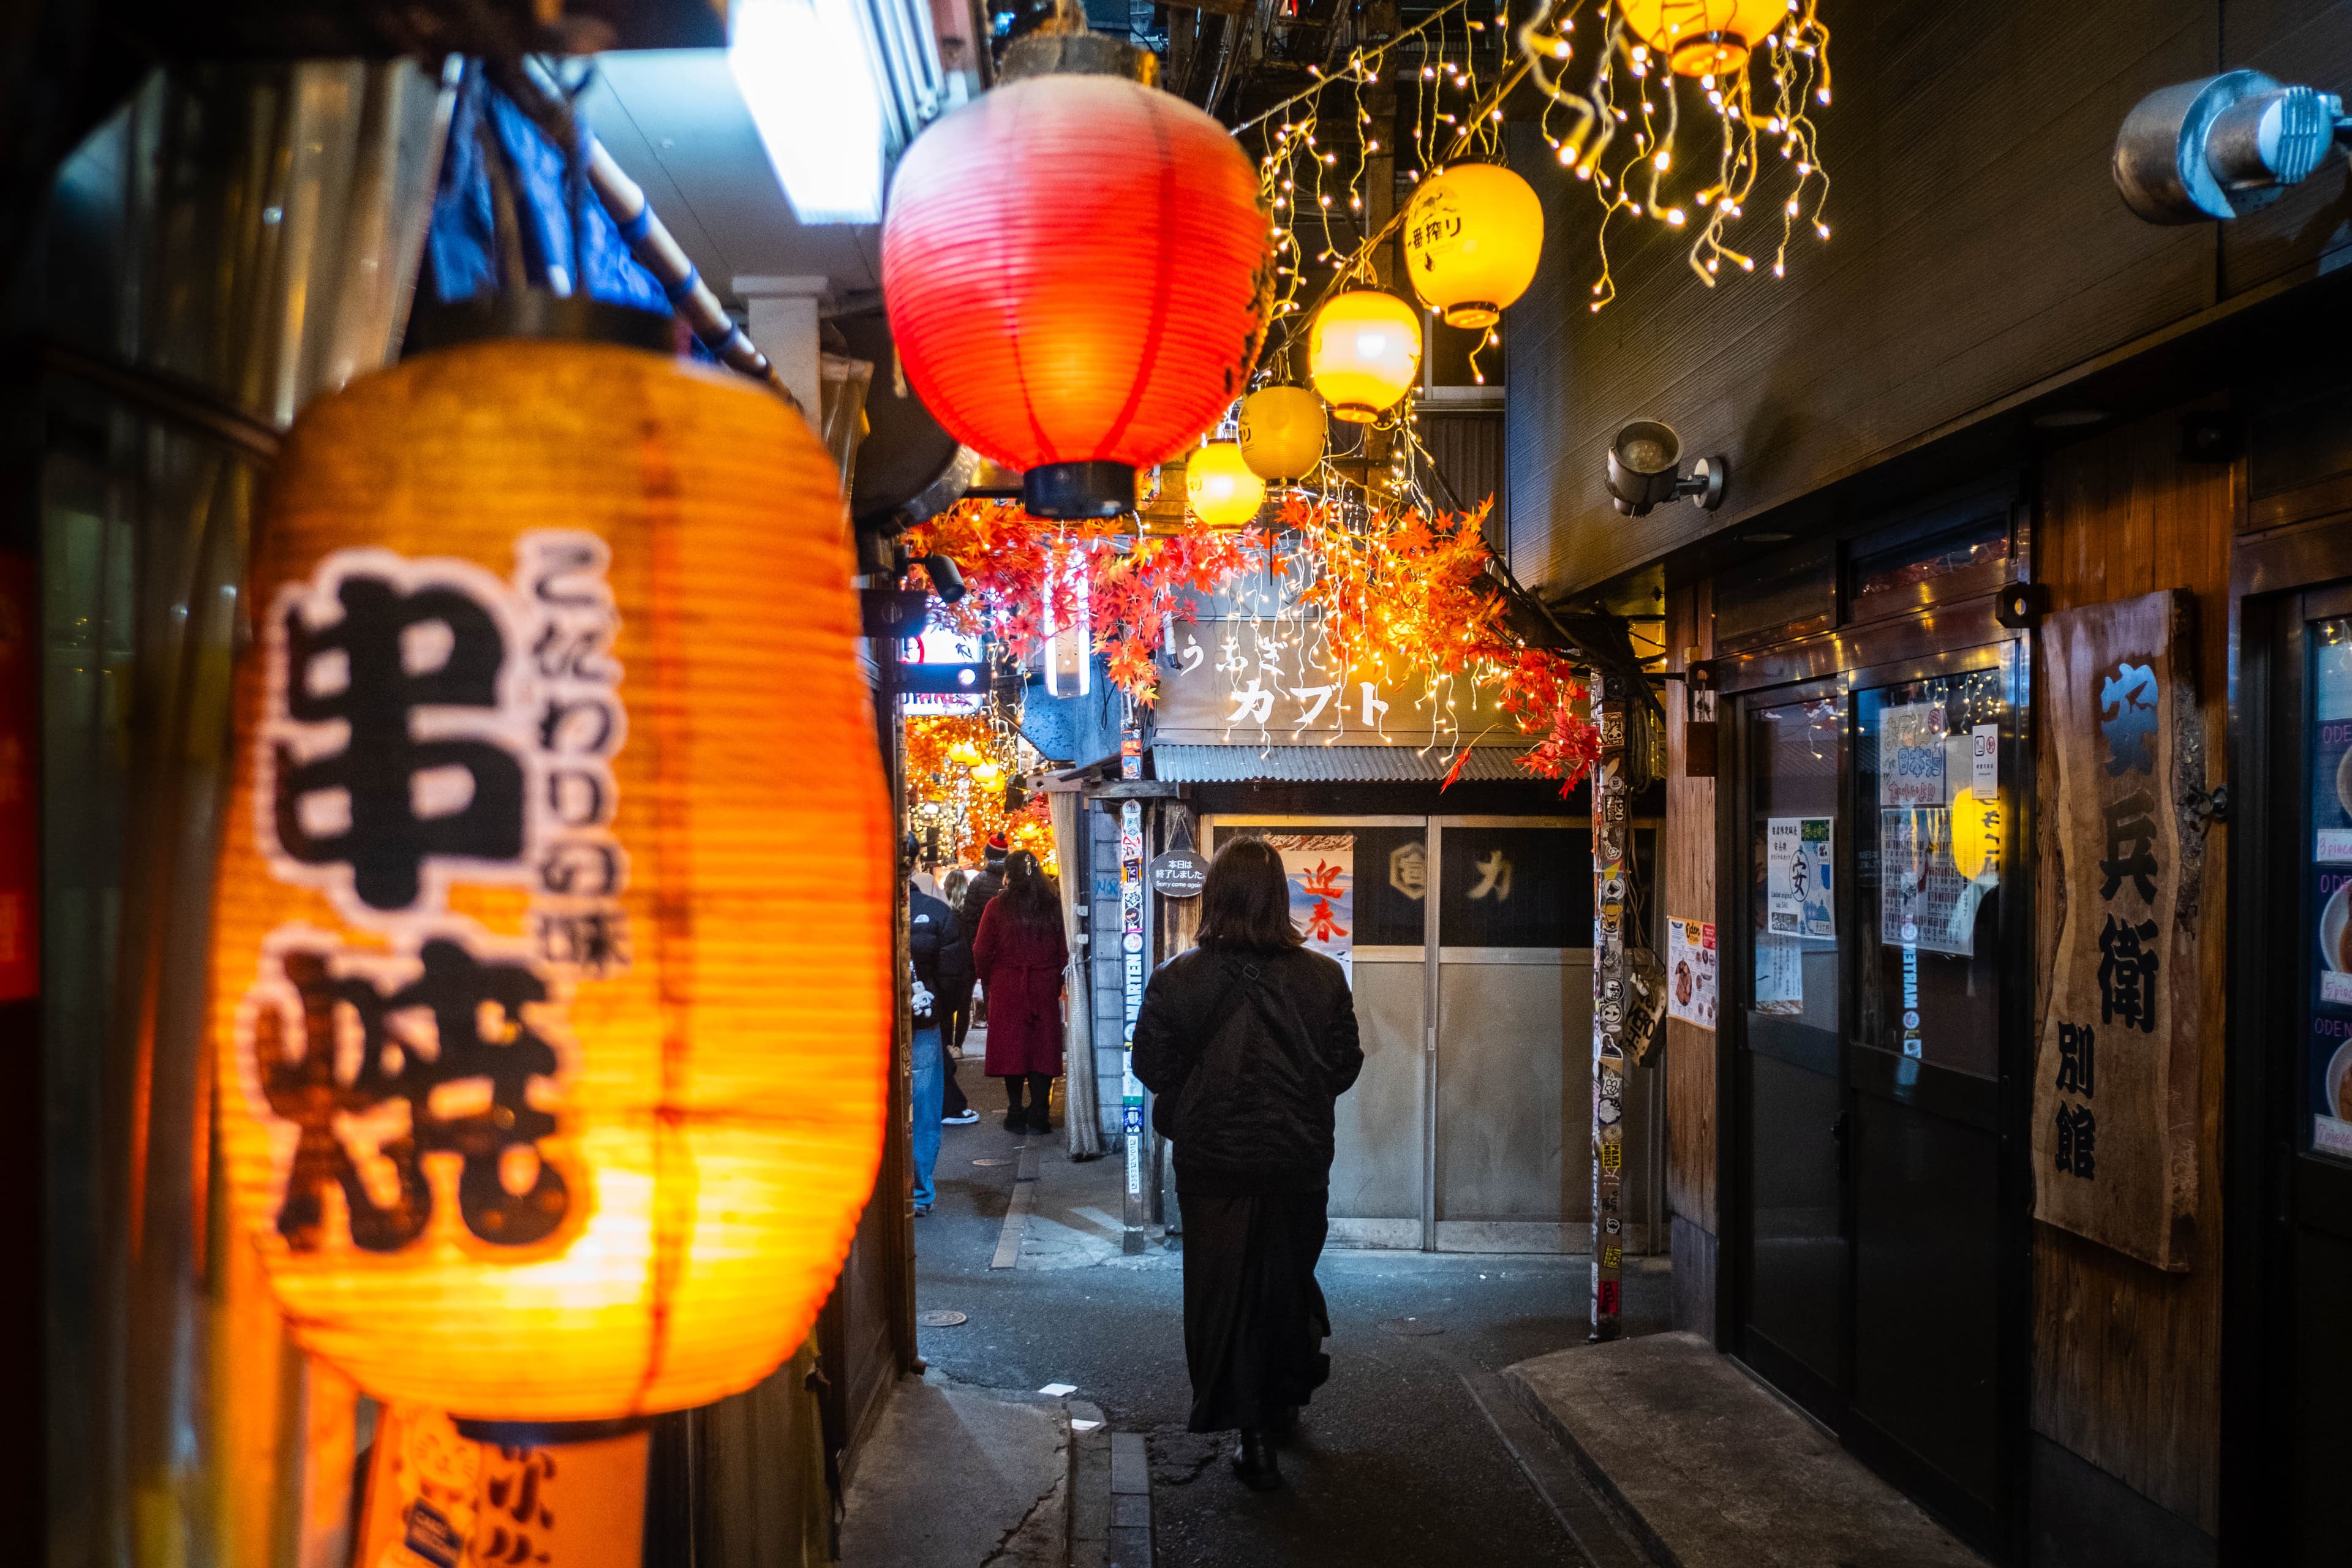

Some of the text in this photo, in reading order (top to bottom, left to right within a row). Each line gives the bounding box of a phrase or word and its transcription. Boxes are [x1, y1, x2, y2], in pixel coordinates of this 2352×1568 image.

[1226, 679, 1389, 726] カブト
[1168, 859, 1193, 869] 本日は
[2097, 662, 2160, 1033] 安兵衛
[255, 573, 570, 1251] 串焼
[1303, 858, 1349, 943] 迎春
[1686, 922, 1700, 938] Oden
[1125, 953, 1143, 1022] MARTEN
[2054, 1020, 2097, 1182] 別館
